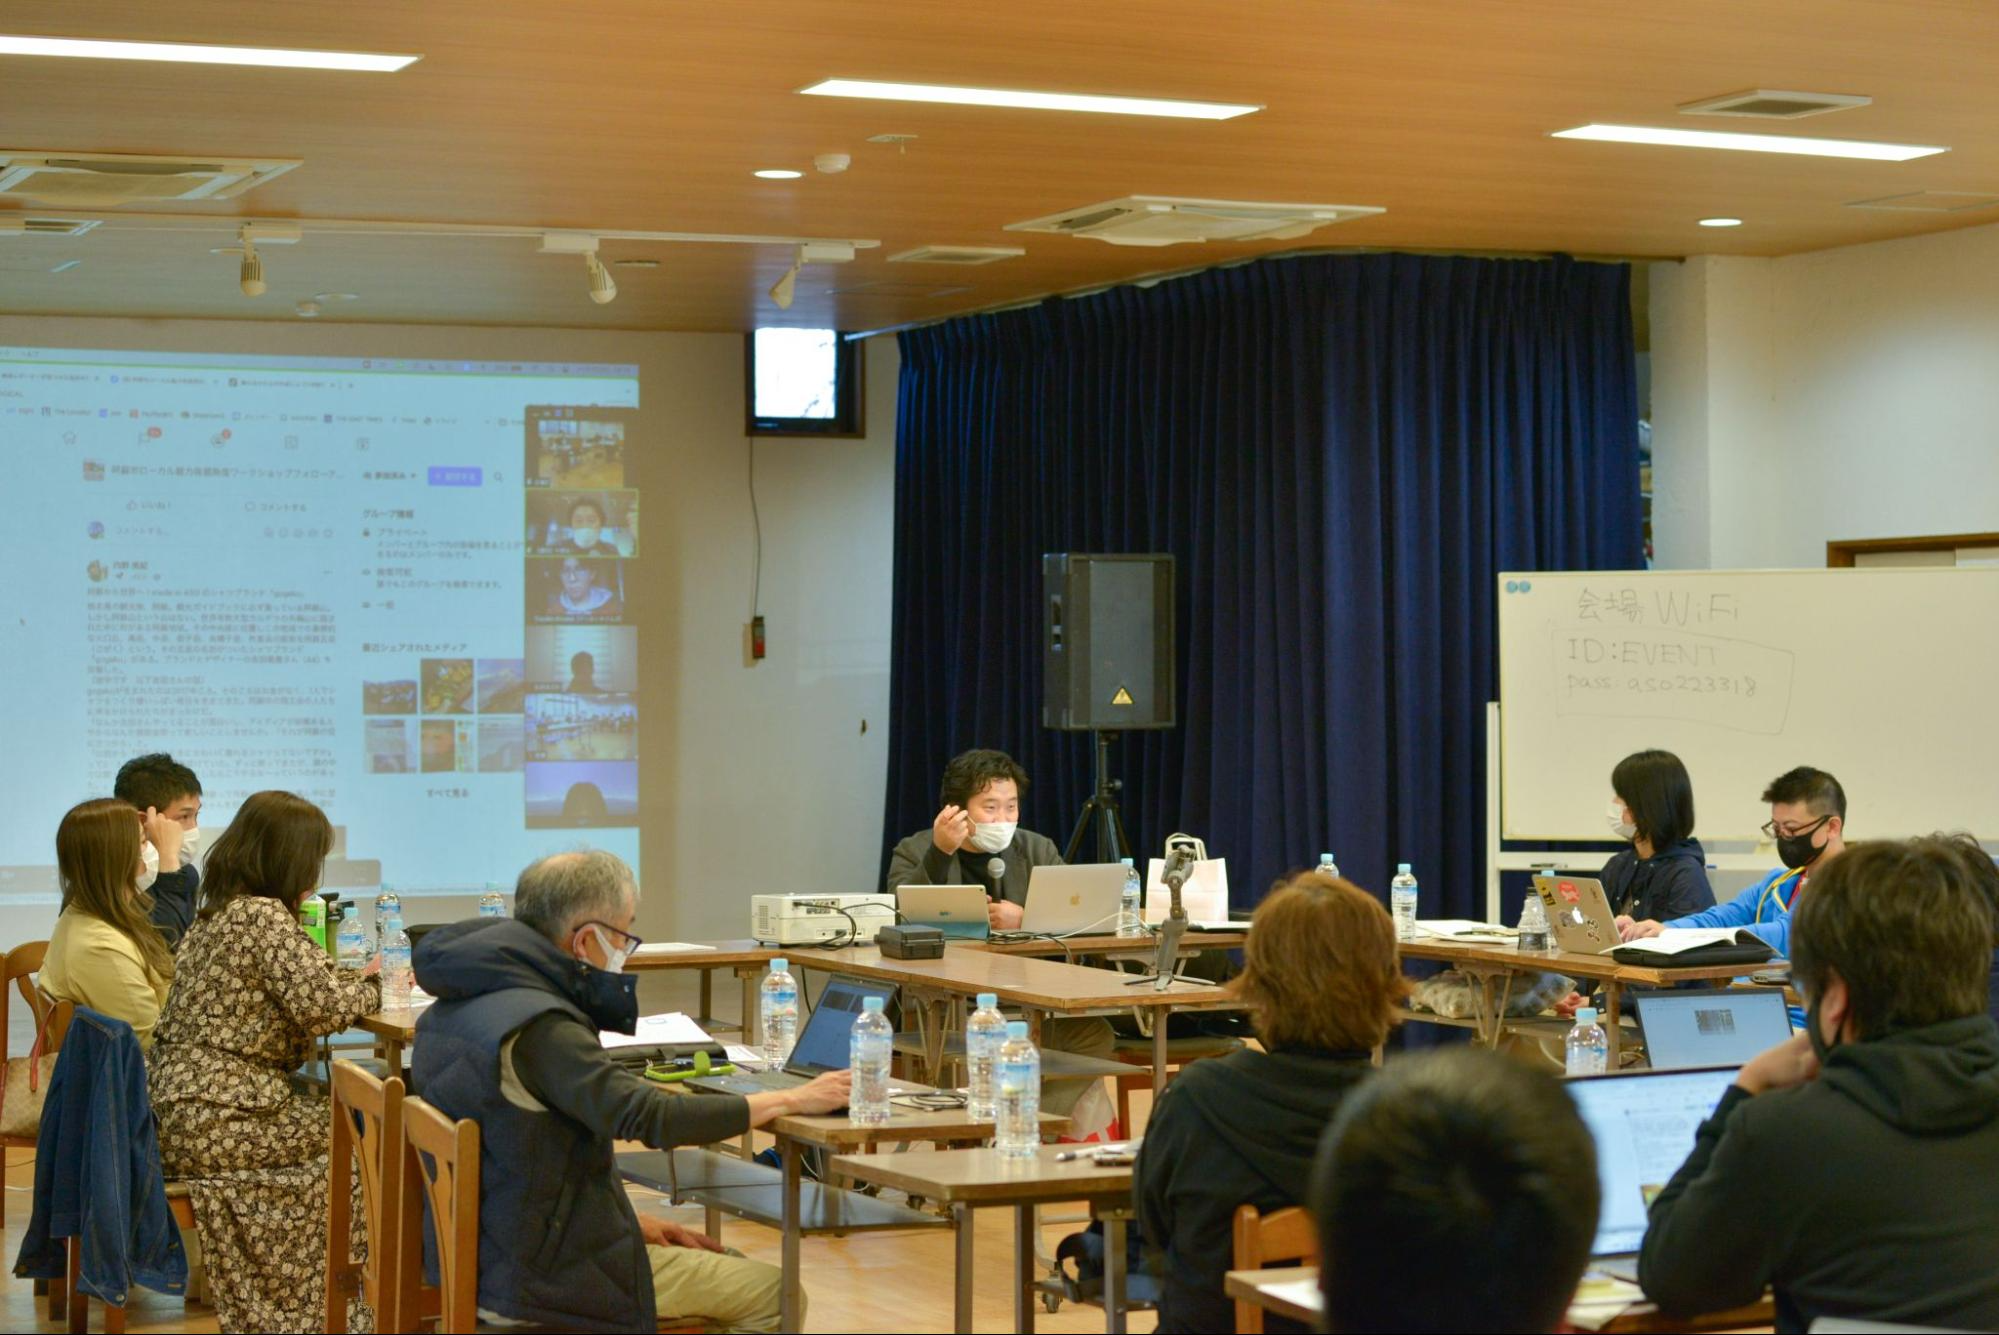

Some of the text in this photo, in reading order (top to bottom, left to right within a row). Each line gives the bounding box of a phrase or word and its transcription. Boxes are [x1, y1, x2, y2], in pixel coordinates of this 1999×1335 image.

[1577, 586, 1740, 627] 会場 WiFi
[1567, 637, 1718, 667] ID:EVENT
